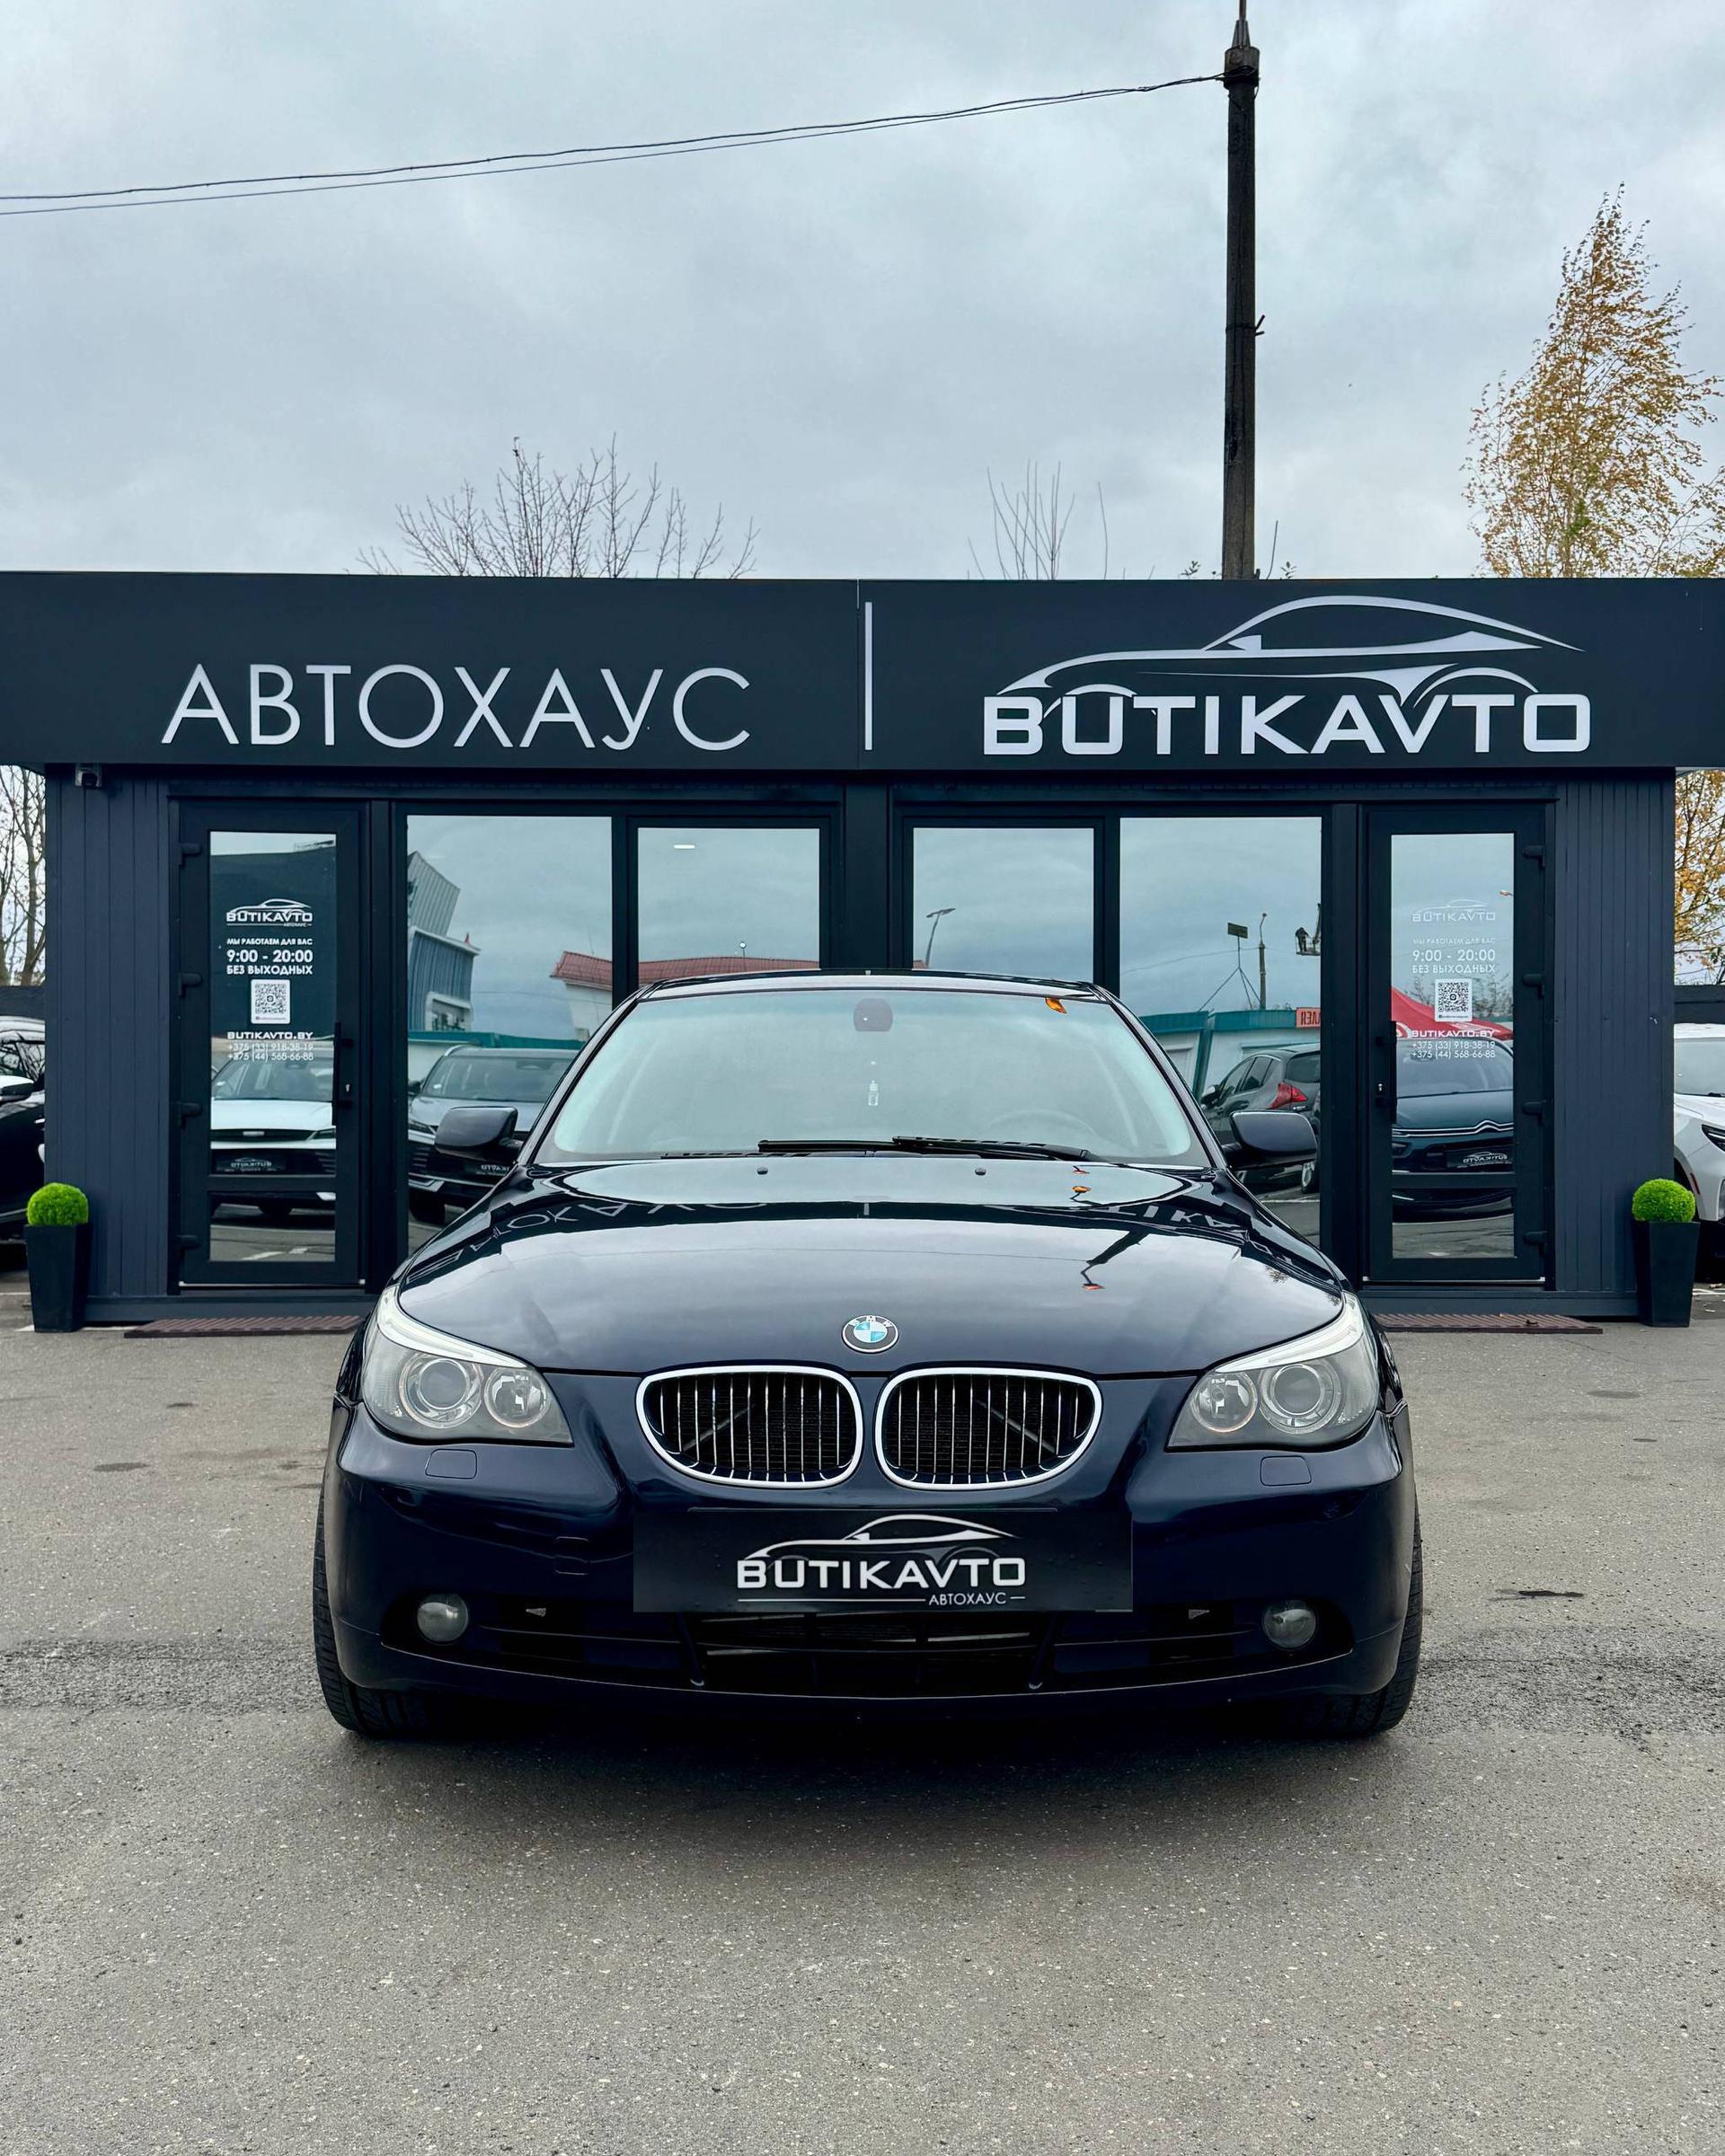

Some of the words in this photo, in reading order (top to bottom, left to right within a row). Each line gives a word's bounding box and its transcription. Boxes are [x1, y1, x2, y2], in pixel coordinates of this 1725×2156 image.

[162, 663, 751, 751] АВТОХАУС
[983, 693, 1591, 755] BUTIKAVTO
[226, 911, 313, 922] BUTIKAVTO
[1412, 912, 1495, 922] BUTIKAVTO
[280, 938, 296, 946] ДЛЯ
[226, 950, 258, 963] 9:00
[272, 950, 313, 963] 20:00
[1412, 950, 1442, 961] 9:00
[1457, 950, 1495, 961] 20:00
[226, 965, 244, 975] БЕЗ
[248, 965, 313, 976] ВЫХОДНЫХ
[1412, 965, 1429, 974] БЕЗ
[1433, 964, 1495, 974] ВЫХОДНЫХ
[227, 1031, 314, 1039] BUTIKAVTO.BY
[1411, 1041, 1433, 1049] +375
[1435, 1041, 1451, 1051] (33)
[252, 1052, 269, 1063] (44)
[271, 1052, 314, 1060] 568-66-88
[1411, 1050, 1433, 1058] +375
[1435, 1050, 1451, 1060] (44)
[1455, 1050, 1496, 1058] 568-66-88
[737, 1557, 1026, 1589] BUTIKAVTO
[928, 1592, 1007, 1606] АВТОХАУС
